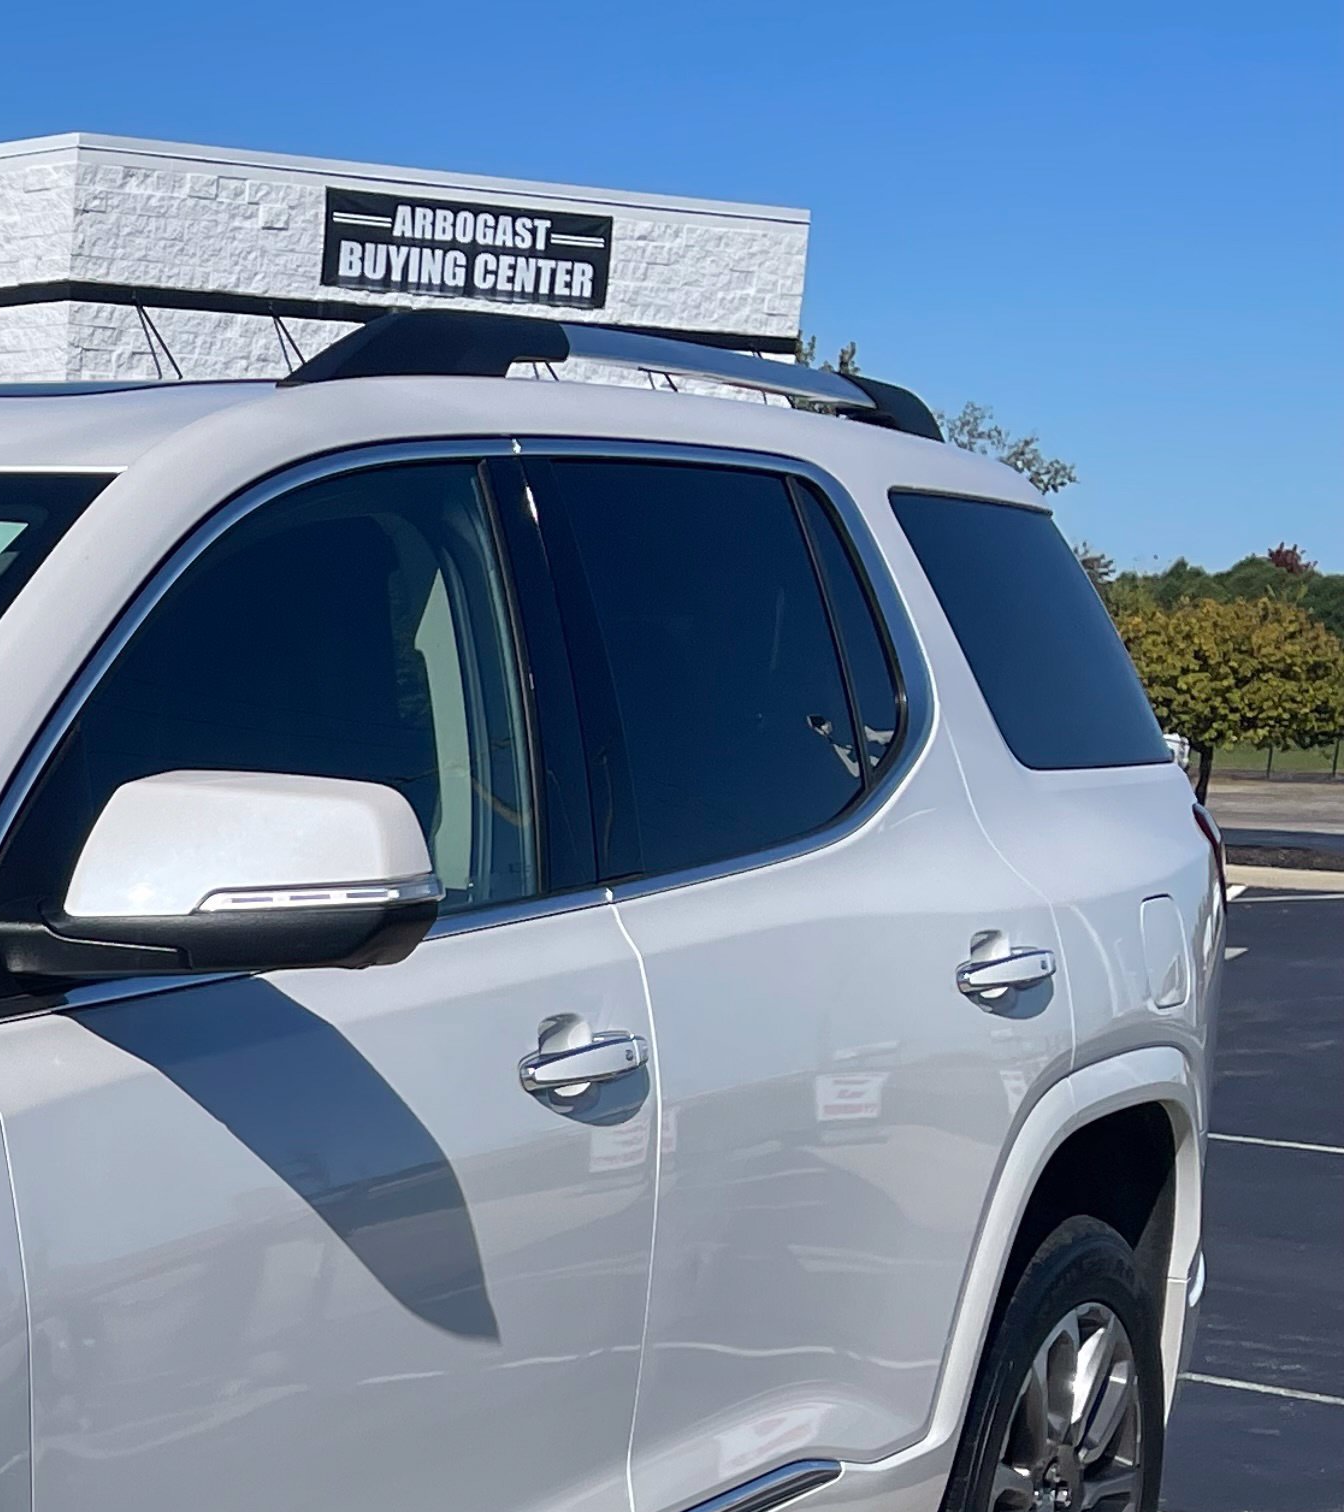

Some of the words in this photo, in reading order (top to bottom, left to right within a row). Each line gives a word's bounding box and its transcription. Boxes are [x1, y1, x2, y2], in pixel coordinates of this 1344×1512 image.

[392, 204, 552, 251] ARBOGAST
[338, 240, 468, 287] BUYING
[473, 252, 595, 298] CENTER
